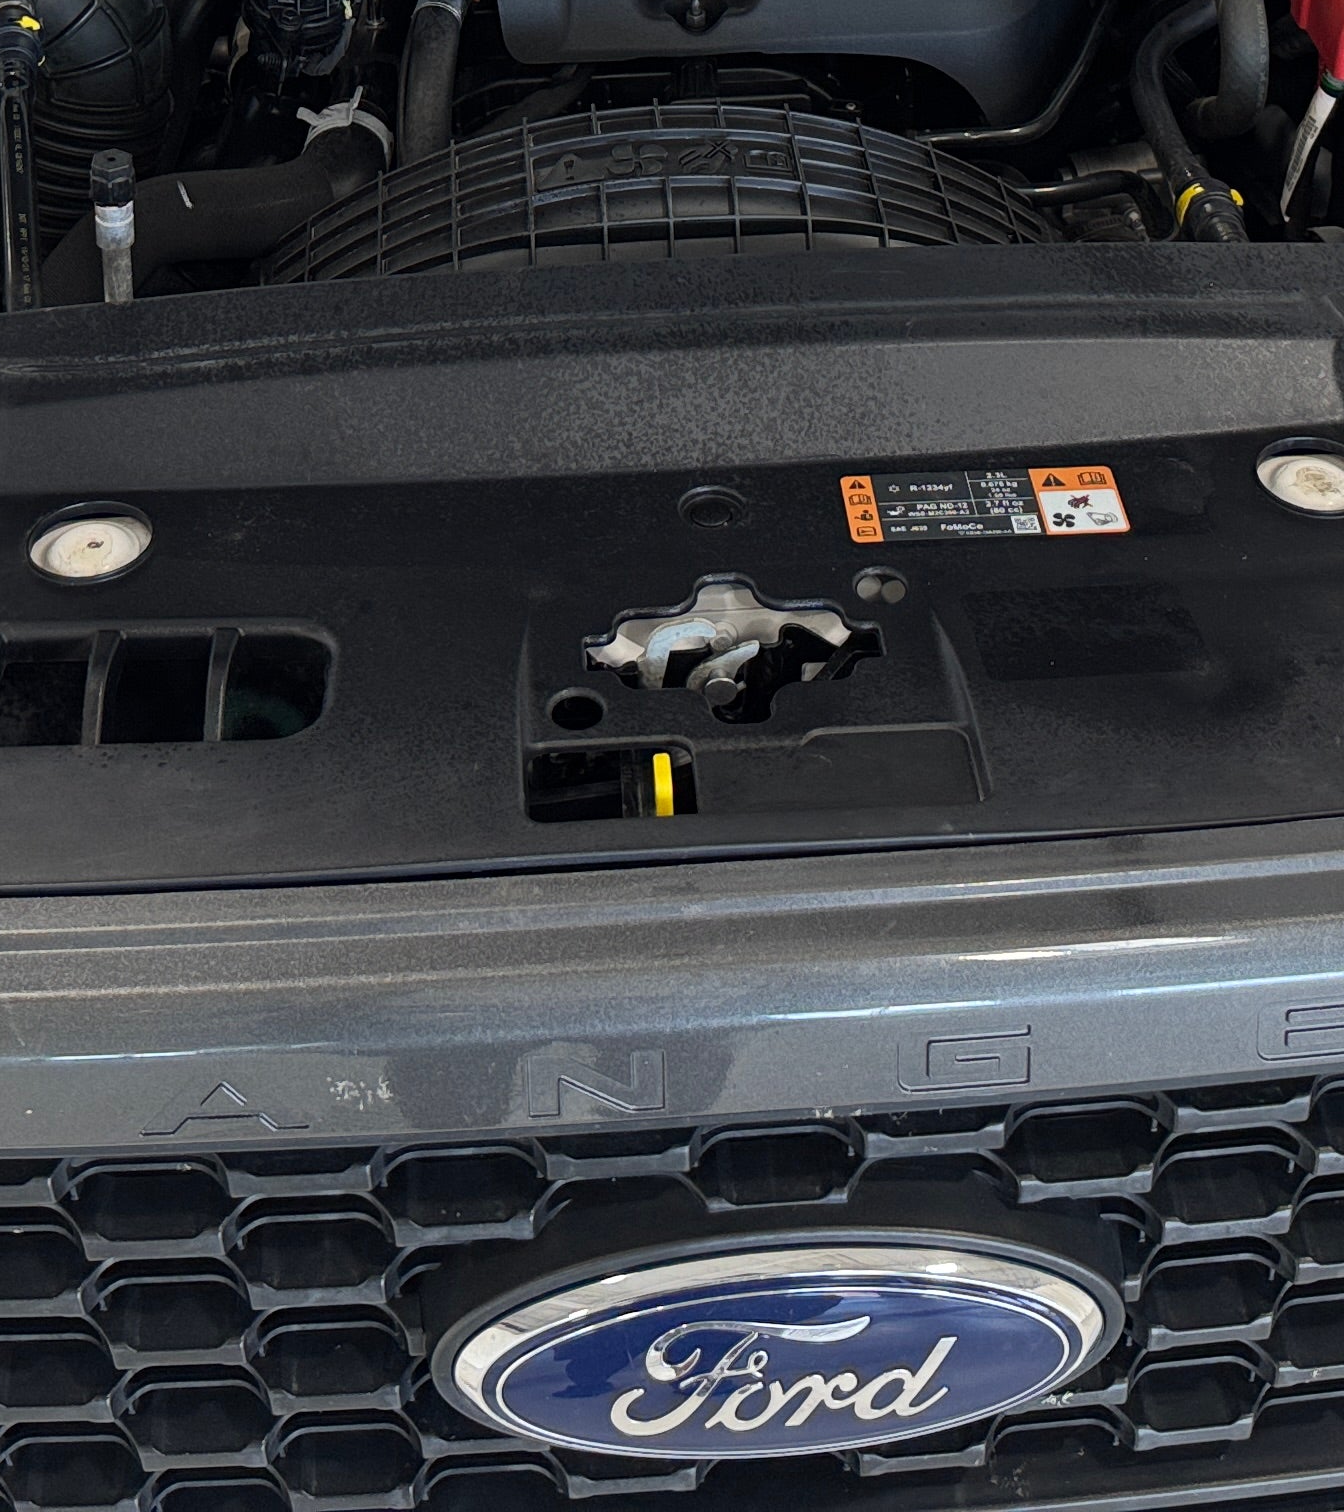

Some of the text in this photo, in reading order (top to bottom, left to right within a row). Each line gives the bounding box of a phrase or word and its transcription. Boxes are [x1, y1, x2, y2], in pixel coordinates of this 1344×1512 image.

[909, 483, 953, 492] R-1234yf
[940, 522, 984, 531] FoMoCo
[608, 1314, 960, 1437] Ford
